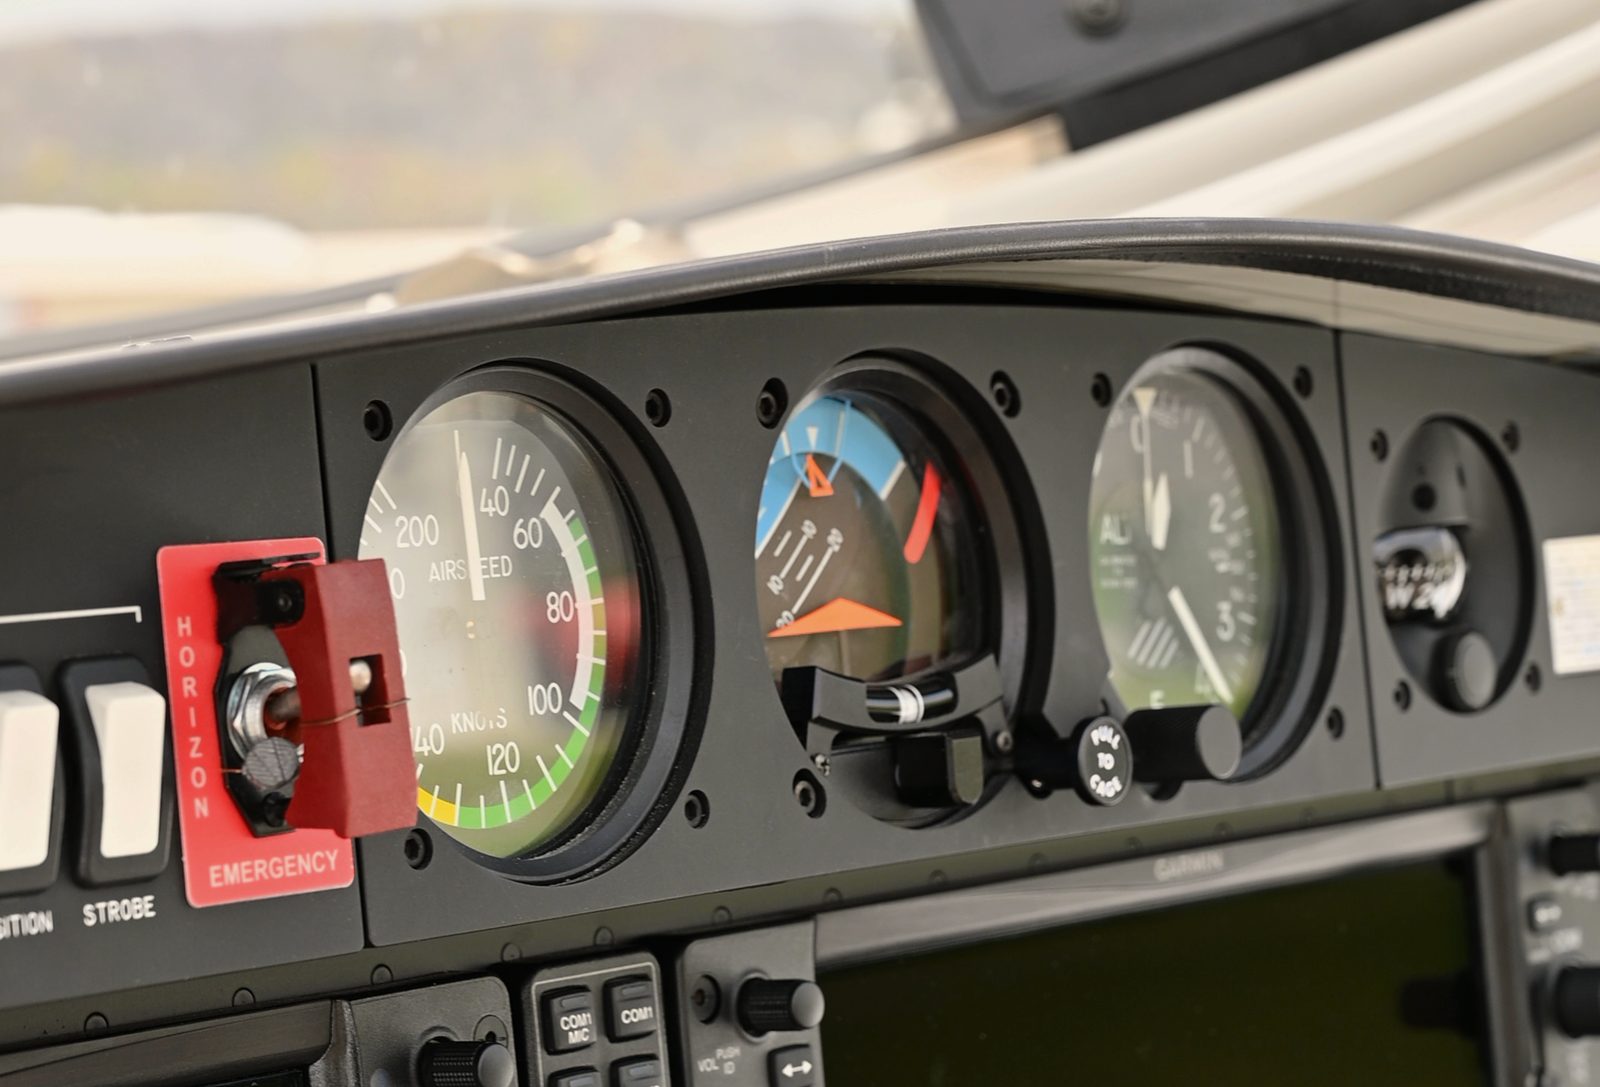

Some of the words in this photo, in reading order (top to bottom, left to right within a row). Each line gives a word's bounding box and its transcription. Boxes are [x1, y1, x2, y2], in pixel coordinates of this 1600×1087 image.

[480, 485, 510, 517] 40
[1208, 491, 1227, 534] 2
[394, 513, 440, 549] 200
[512, 517, 544, 550] 60
[429, 555, 513, 582] AIRSEED
[546, 591, 575, 622] 80
[1215, 600, 1236, 643] 3
[527, 682, 563, 716] 100
[176, 615, 210, 819] HORIZON
[486, 741, 521, 776] 120
[1097, 752, 1115, 771] TO
[208, 849, 340, 888] EMERGENCY
[82, 895, 157, 927] STROBE
[560, 1013, 593, 1032] COM1
[621, 1006, 653, 1025] COM1
[568, 1028, 590, 1044] MIC
[697, 1057, 721, 1073] VOL
